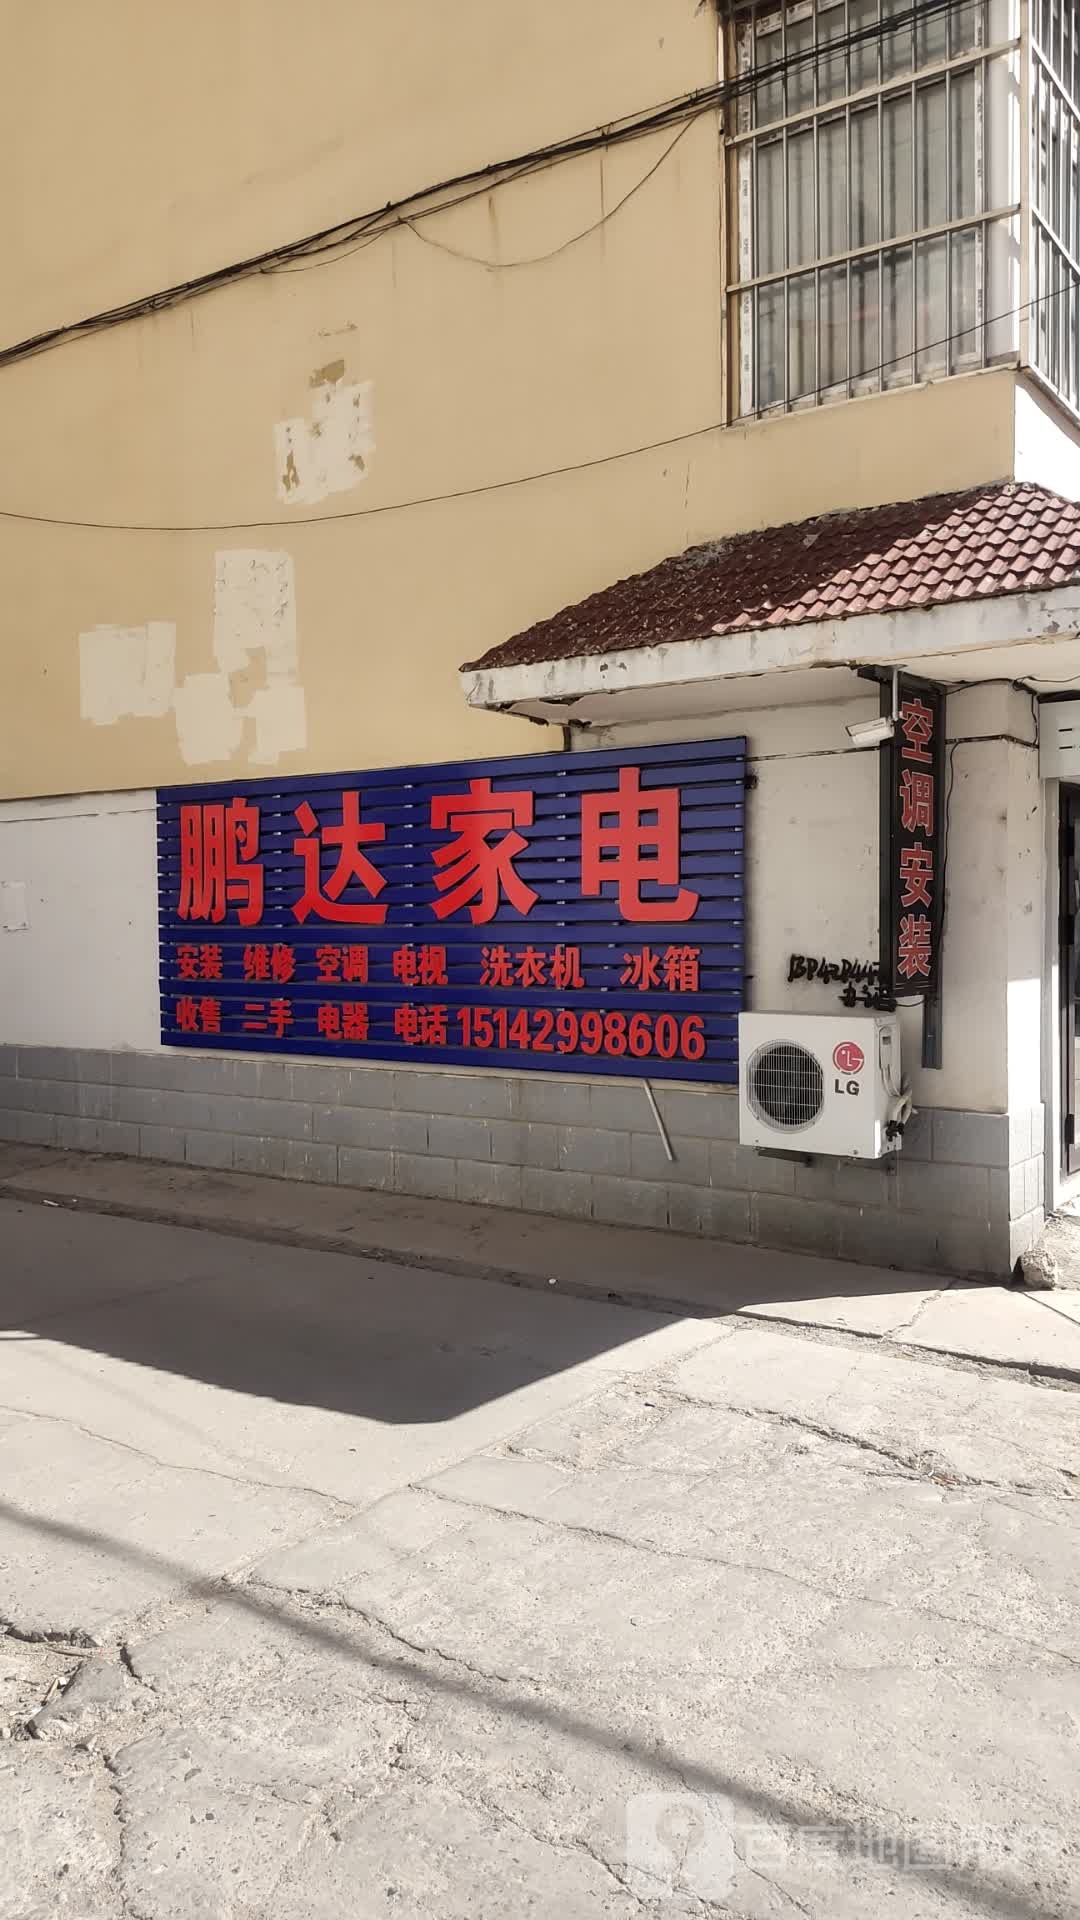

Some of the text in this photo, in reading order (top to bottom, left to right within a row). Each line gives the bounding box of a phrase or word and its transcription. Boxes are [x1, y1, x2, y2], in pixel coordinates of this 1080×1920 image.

[177, 766, 700, 927] 鹏达家电
[897, 698, 934, 978] 空调安装
[176, 944, 701, 993] 安装 维修 空调 电视 洗衣机 冰箱
[176, 997, 706, 1060] 收售 二手 电器 电话 15142998606
[834, 1078, 860, 1096] LG
